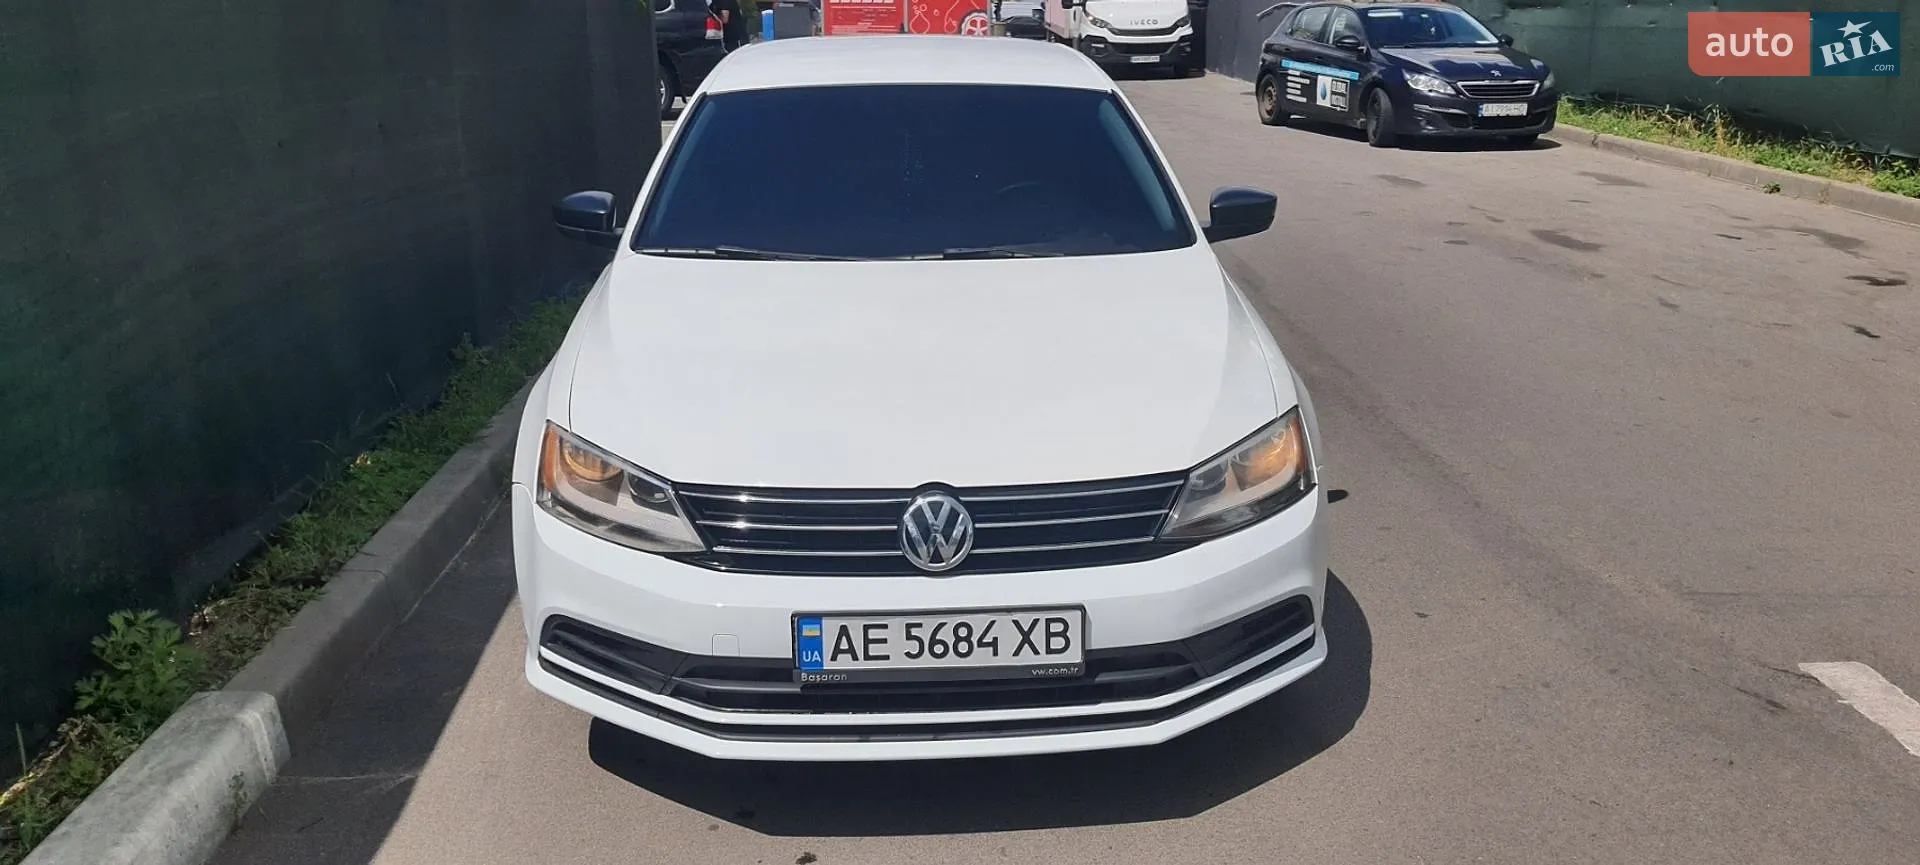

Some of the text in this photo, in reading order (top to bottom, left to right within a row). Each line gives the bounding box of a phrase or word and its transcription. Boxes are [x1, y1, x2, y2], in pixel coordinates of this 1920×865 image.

[830, 617, 1071, 662] AE 5684 XB
[802, 650, 821, 663] UA
